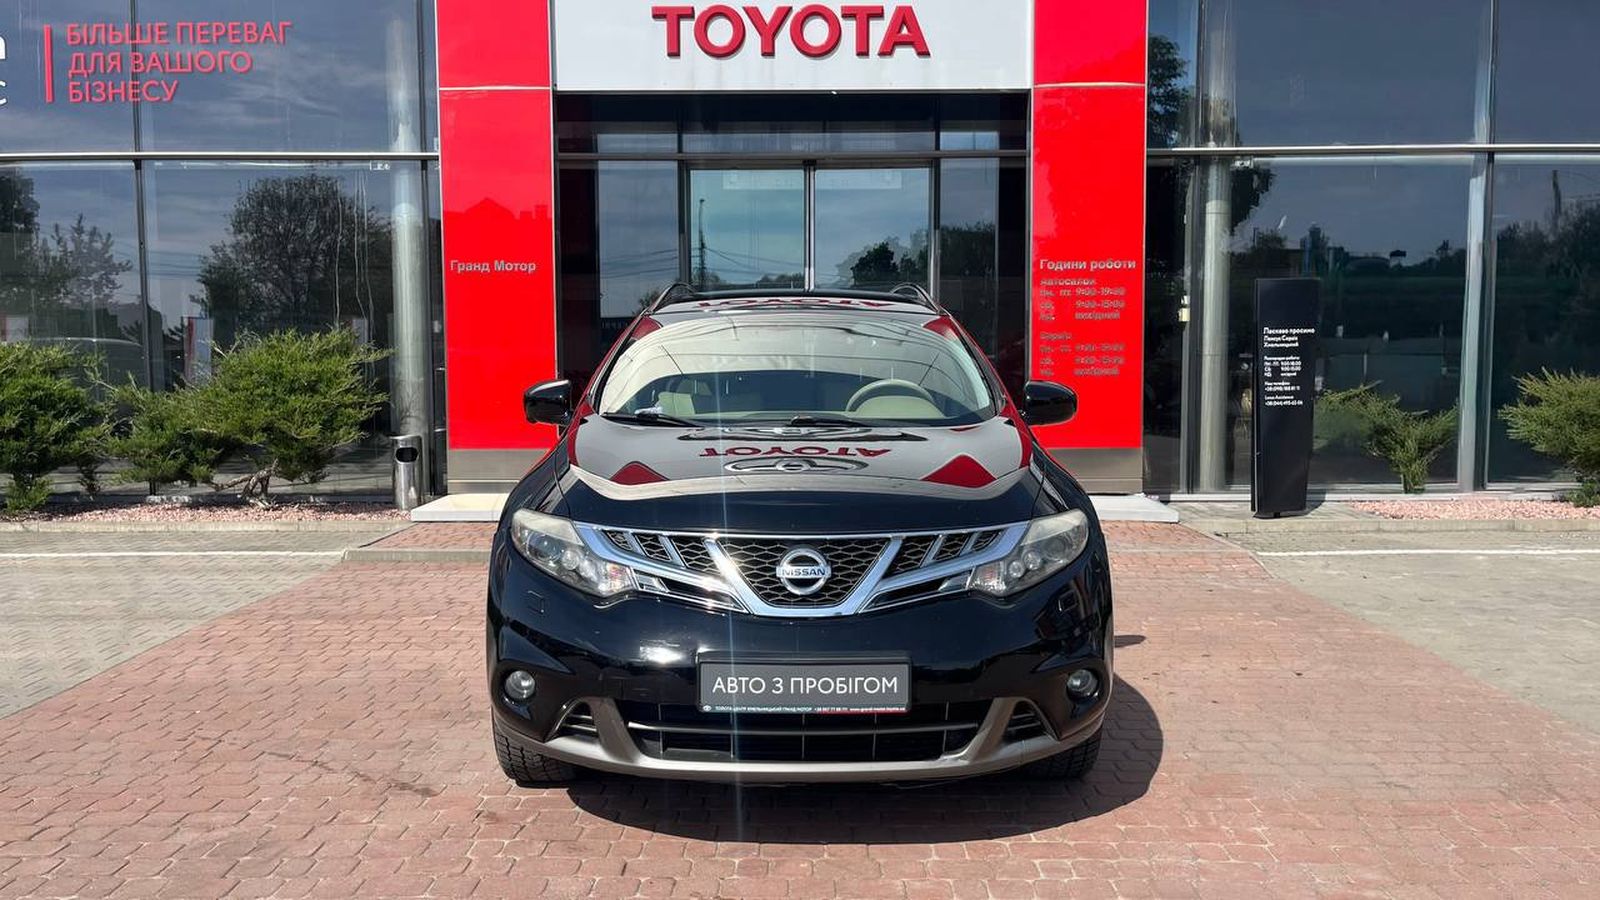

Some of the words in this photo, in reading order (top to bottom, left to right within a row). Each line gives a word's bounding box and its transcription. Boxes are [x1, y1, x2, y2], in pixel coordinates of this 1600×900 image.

[66, 23, 168, 45] БІЛЬШЕ
[175, 21, 292, 45] ПЕРЕВАГ
[651, 4, 931, 58] TOYOTA
[68, 51, 122, 77] ДЛЯ
[130, 50, 252, 74] ВАШОГО
[68, 80, 179, 104] БІЗНЕСУ
[450, 259, 490, 274] Гранд
[494, 259, 536, 274] Мотор
[1039, 259, 1087, 271] Години
[1090, 258, 1136, 272] роботи
[782, 568, 826, 576] NISSAN
[712, 677, 766, 694] АВТО
[771, 677, 784, 694] З
[790, 677, 898, 694] ПРОБІГОМ
